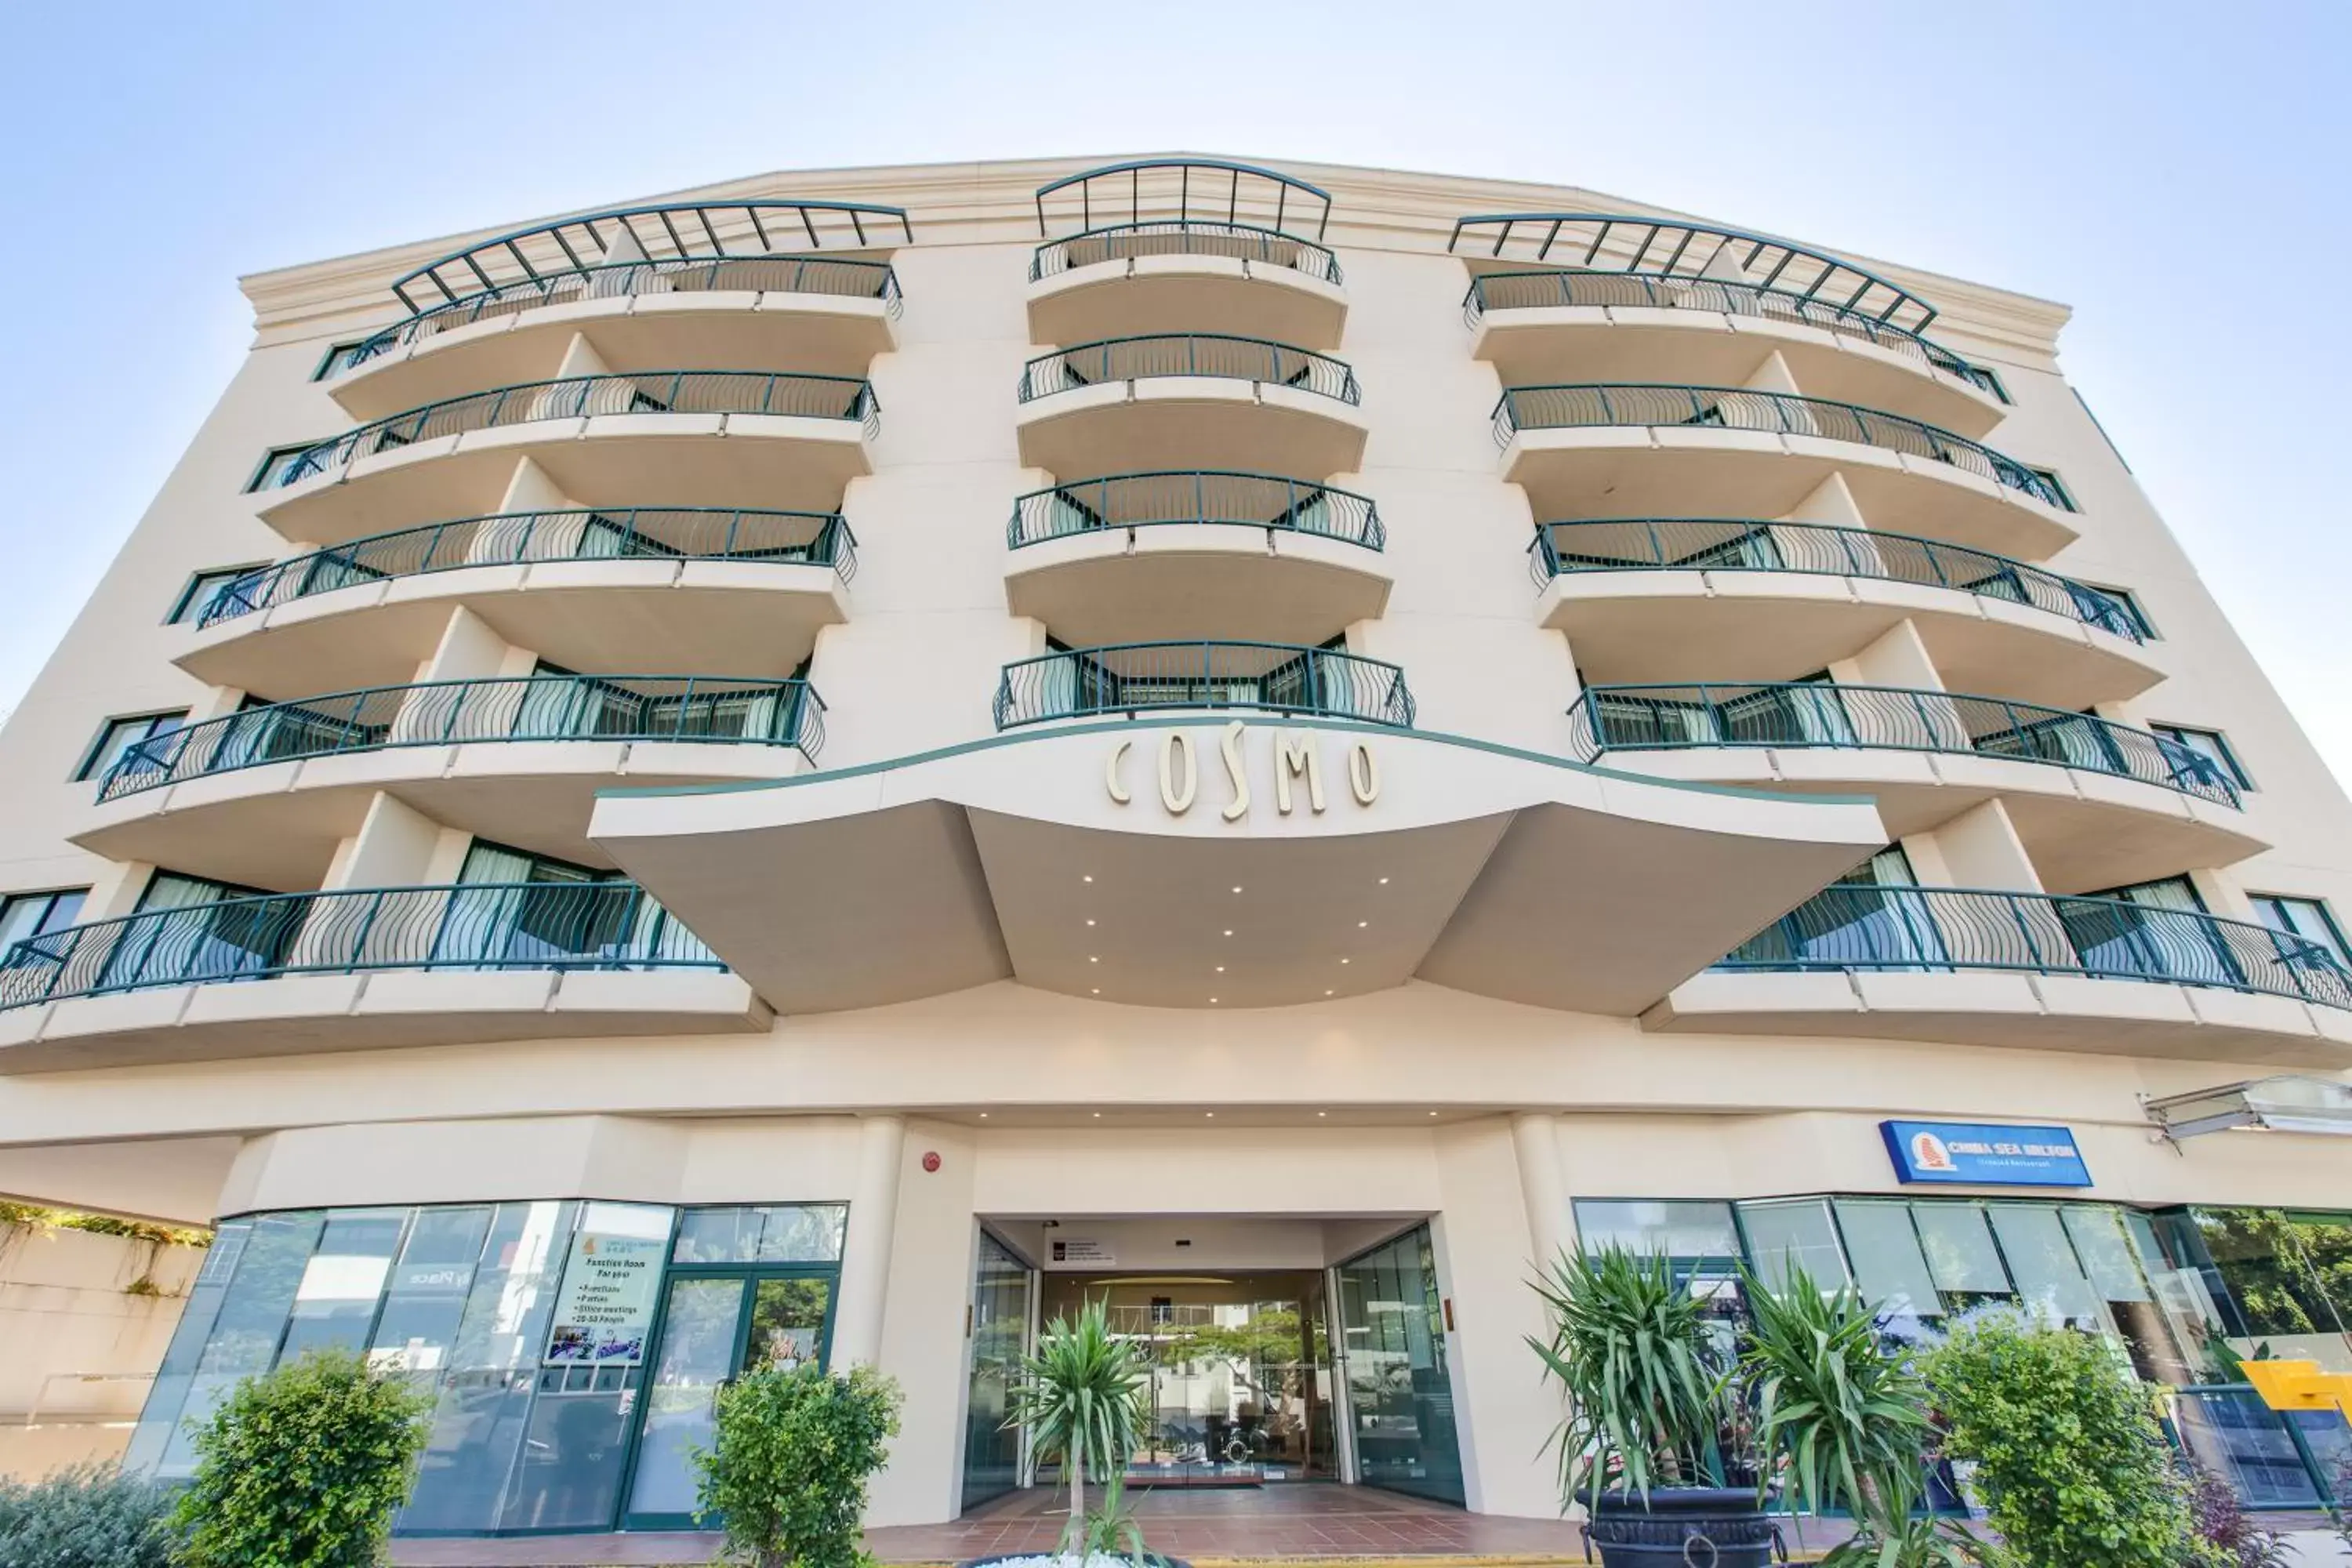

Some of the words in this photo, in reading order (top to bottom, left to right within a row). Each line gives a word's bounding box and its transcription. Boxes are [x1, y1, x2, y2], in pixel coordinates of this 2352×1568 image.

[1105, 719, 1381, 822] COSMO
[1947, 1142, 1994, 1154] CHINA
[1993, 1142, 2024, 1156] SEA
[586, 1258, 622, 1267] Function
